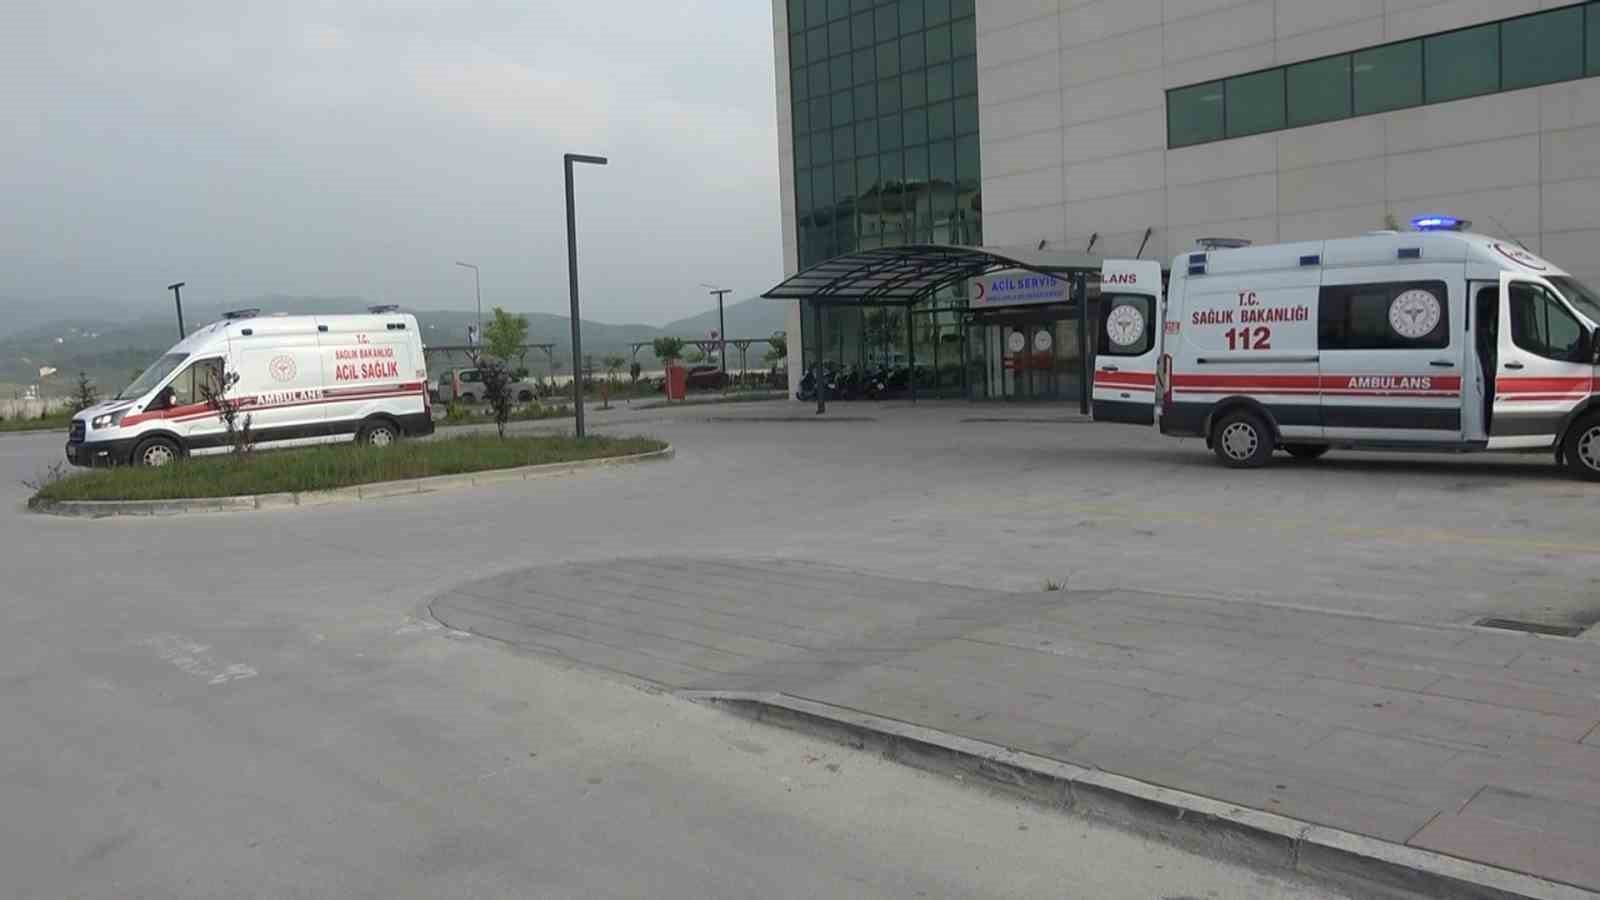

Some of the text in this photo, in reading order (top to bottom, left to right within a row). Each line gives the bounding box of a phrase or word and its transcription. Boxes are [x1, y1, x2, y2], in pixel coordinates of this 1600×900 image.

[1239, 293, 1259, 306] T.C.
[1192, 305, 1309, 324] SAĞLIK BAKANLIĞI
[1225, 326, 1271, 350] 112
[336, 365, 359, 380] ACİL
[361, 360, 399, 378] SAĞLIK
[1348, 376, 1431, 389] AMBULANS
